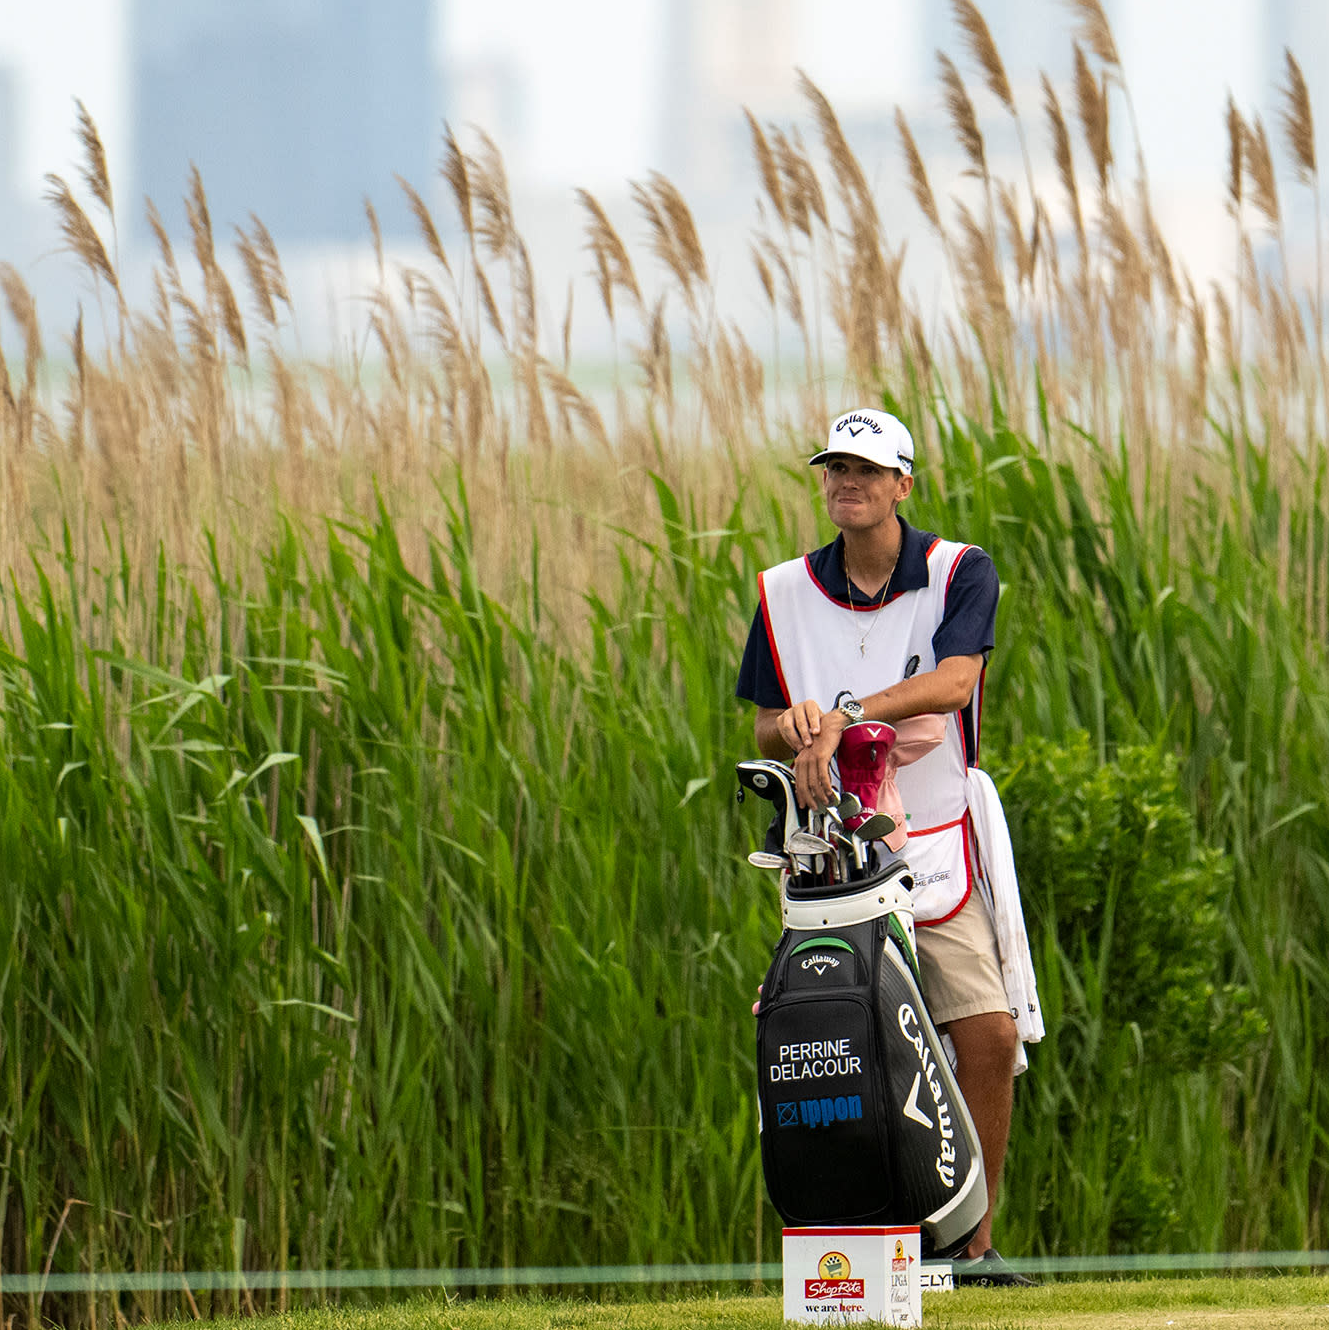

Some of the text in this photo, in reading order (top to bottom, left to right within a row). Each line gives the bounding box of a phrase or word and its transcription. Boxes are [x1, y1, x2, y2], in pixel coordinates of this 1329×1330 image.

[836, 414, 883, 434] Callaway
[801, 954, 840, 969] Callaway
[779, 1039, 850, 1062] PERRINE
[770, 1056, 862, 1082] DELACOUR
[898, 1003, 956, 1188] Callaway
[808, 1281, 861, 1299] ShopRite
[805, 1303, 865, 1313] we are here.
